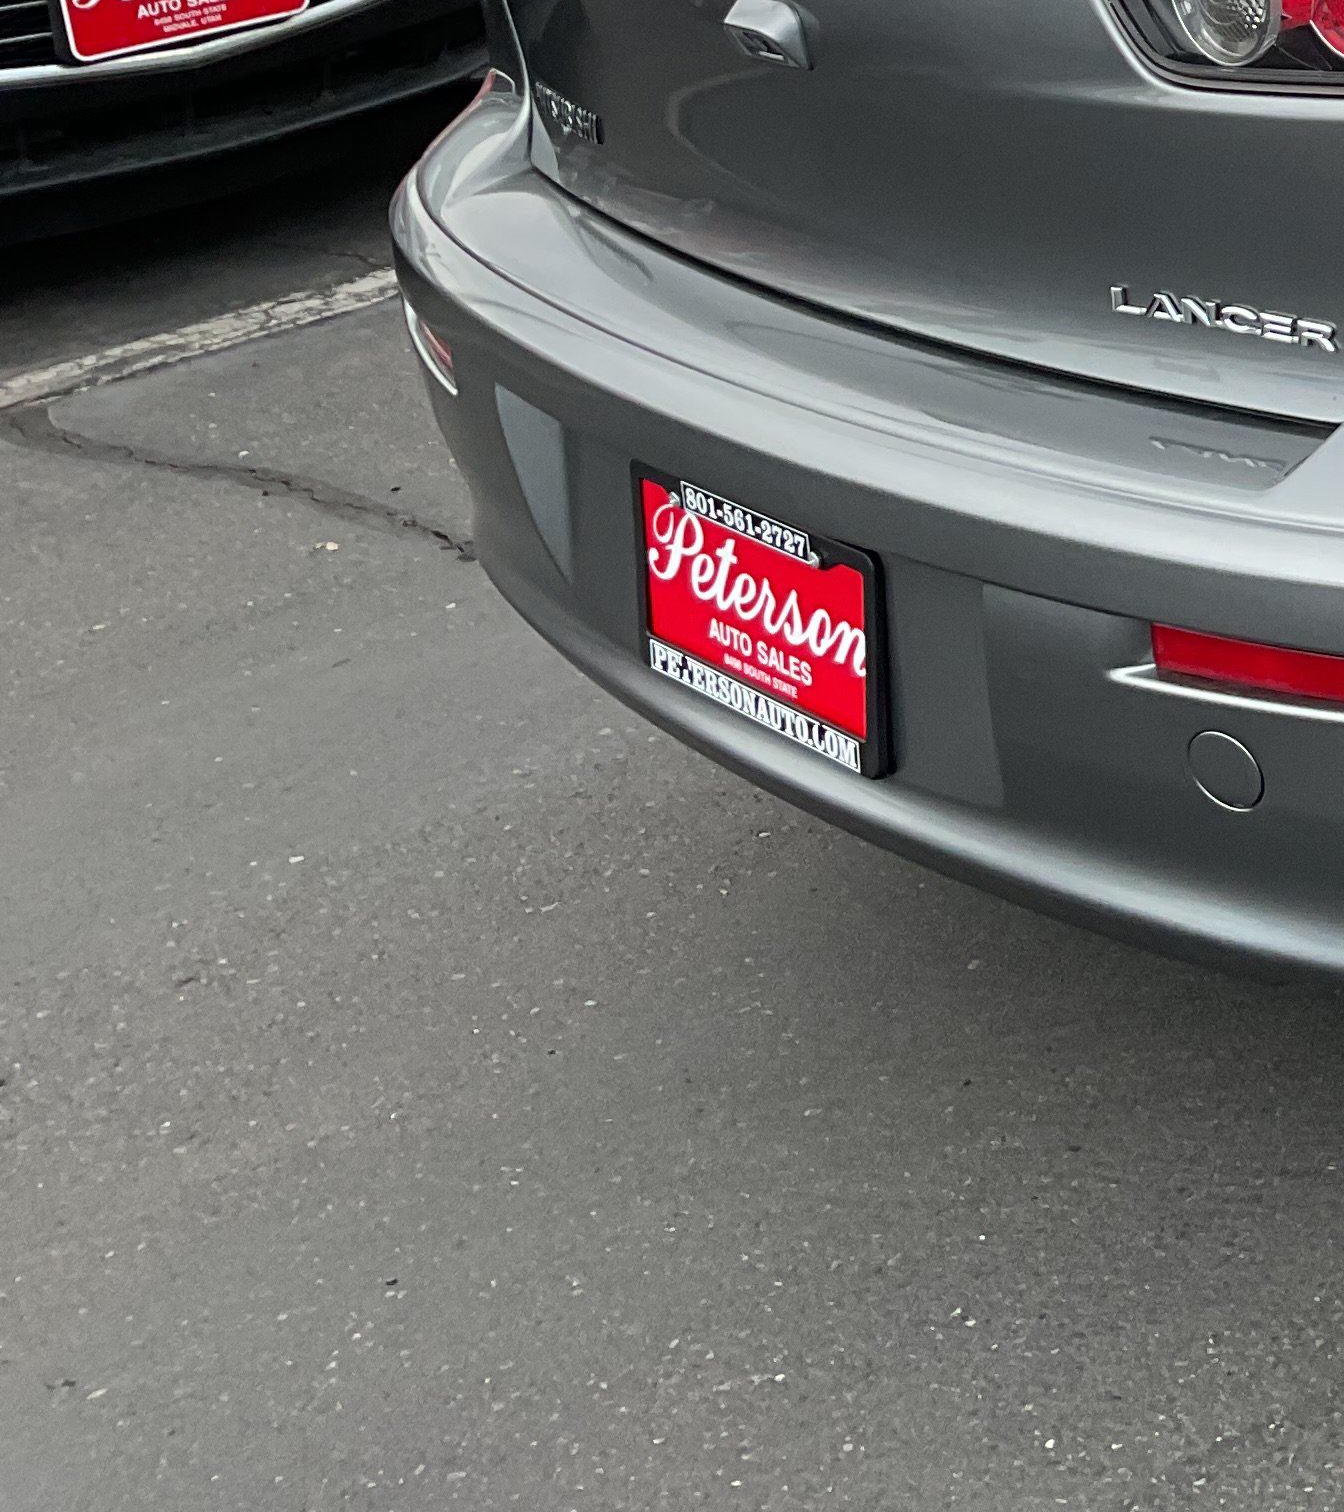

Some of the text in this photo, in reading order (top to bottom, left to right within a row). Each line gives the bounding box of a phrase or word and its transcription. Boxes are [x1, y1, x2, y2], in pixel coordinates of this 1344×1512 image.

[1110, 284, 1341, 353] LANCER
[684, 486, 808, 558] 801-561-2727
[648, 502, 867, 677] Peterson
[709, 617, 813, 686] AUTO SALES
[652, 642, 859, 769] PETERSONAUTO.COM
[772, 675, 799, 700] STATE
